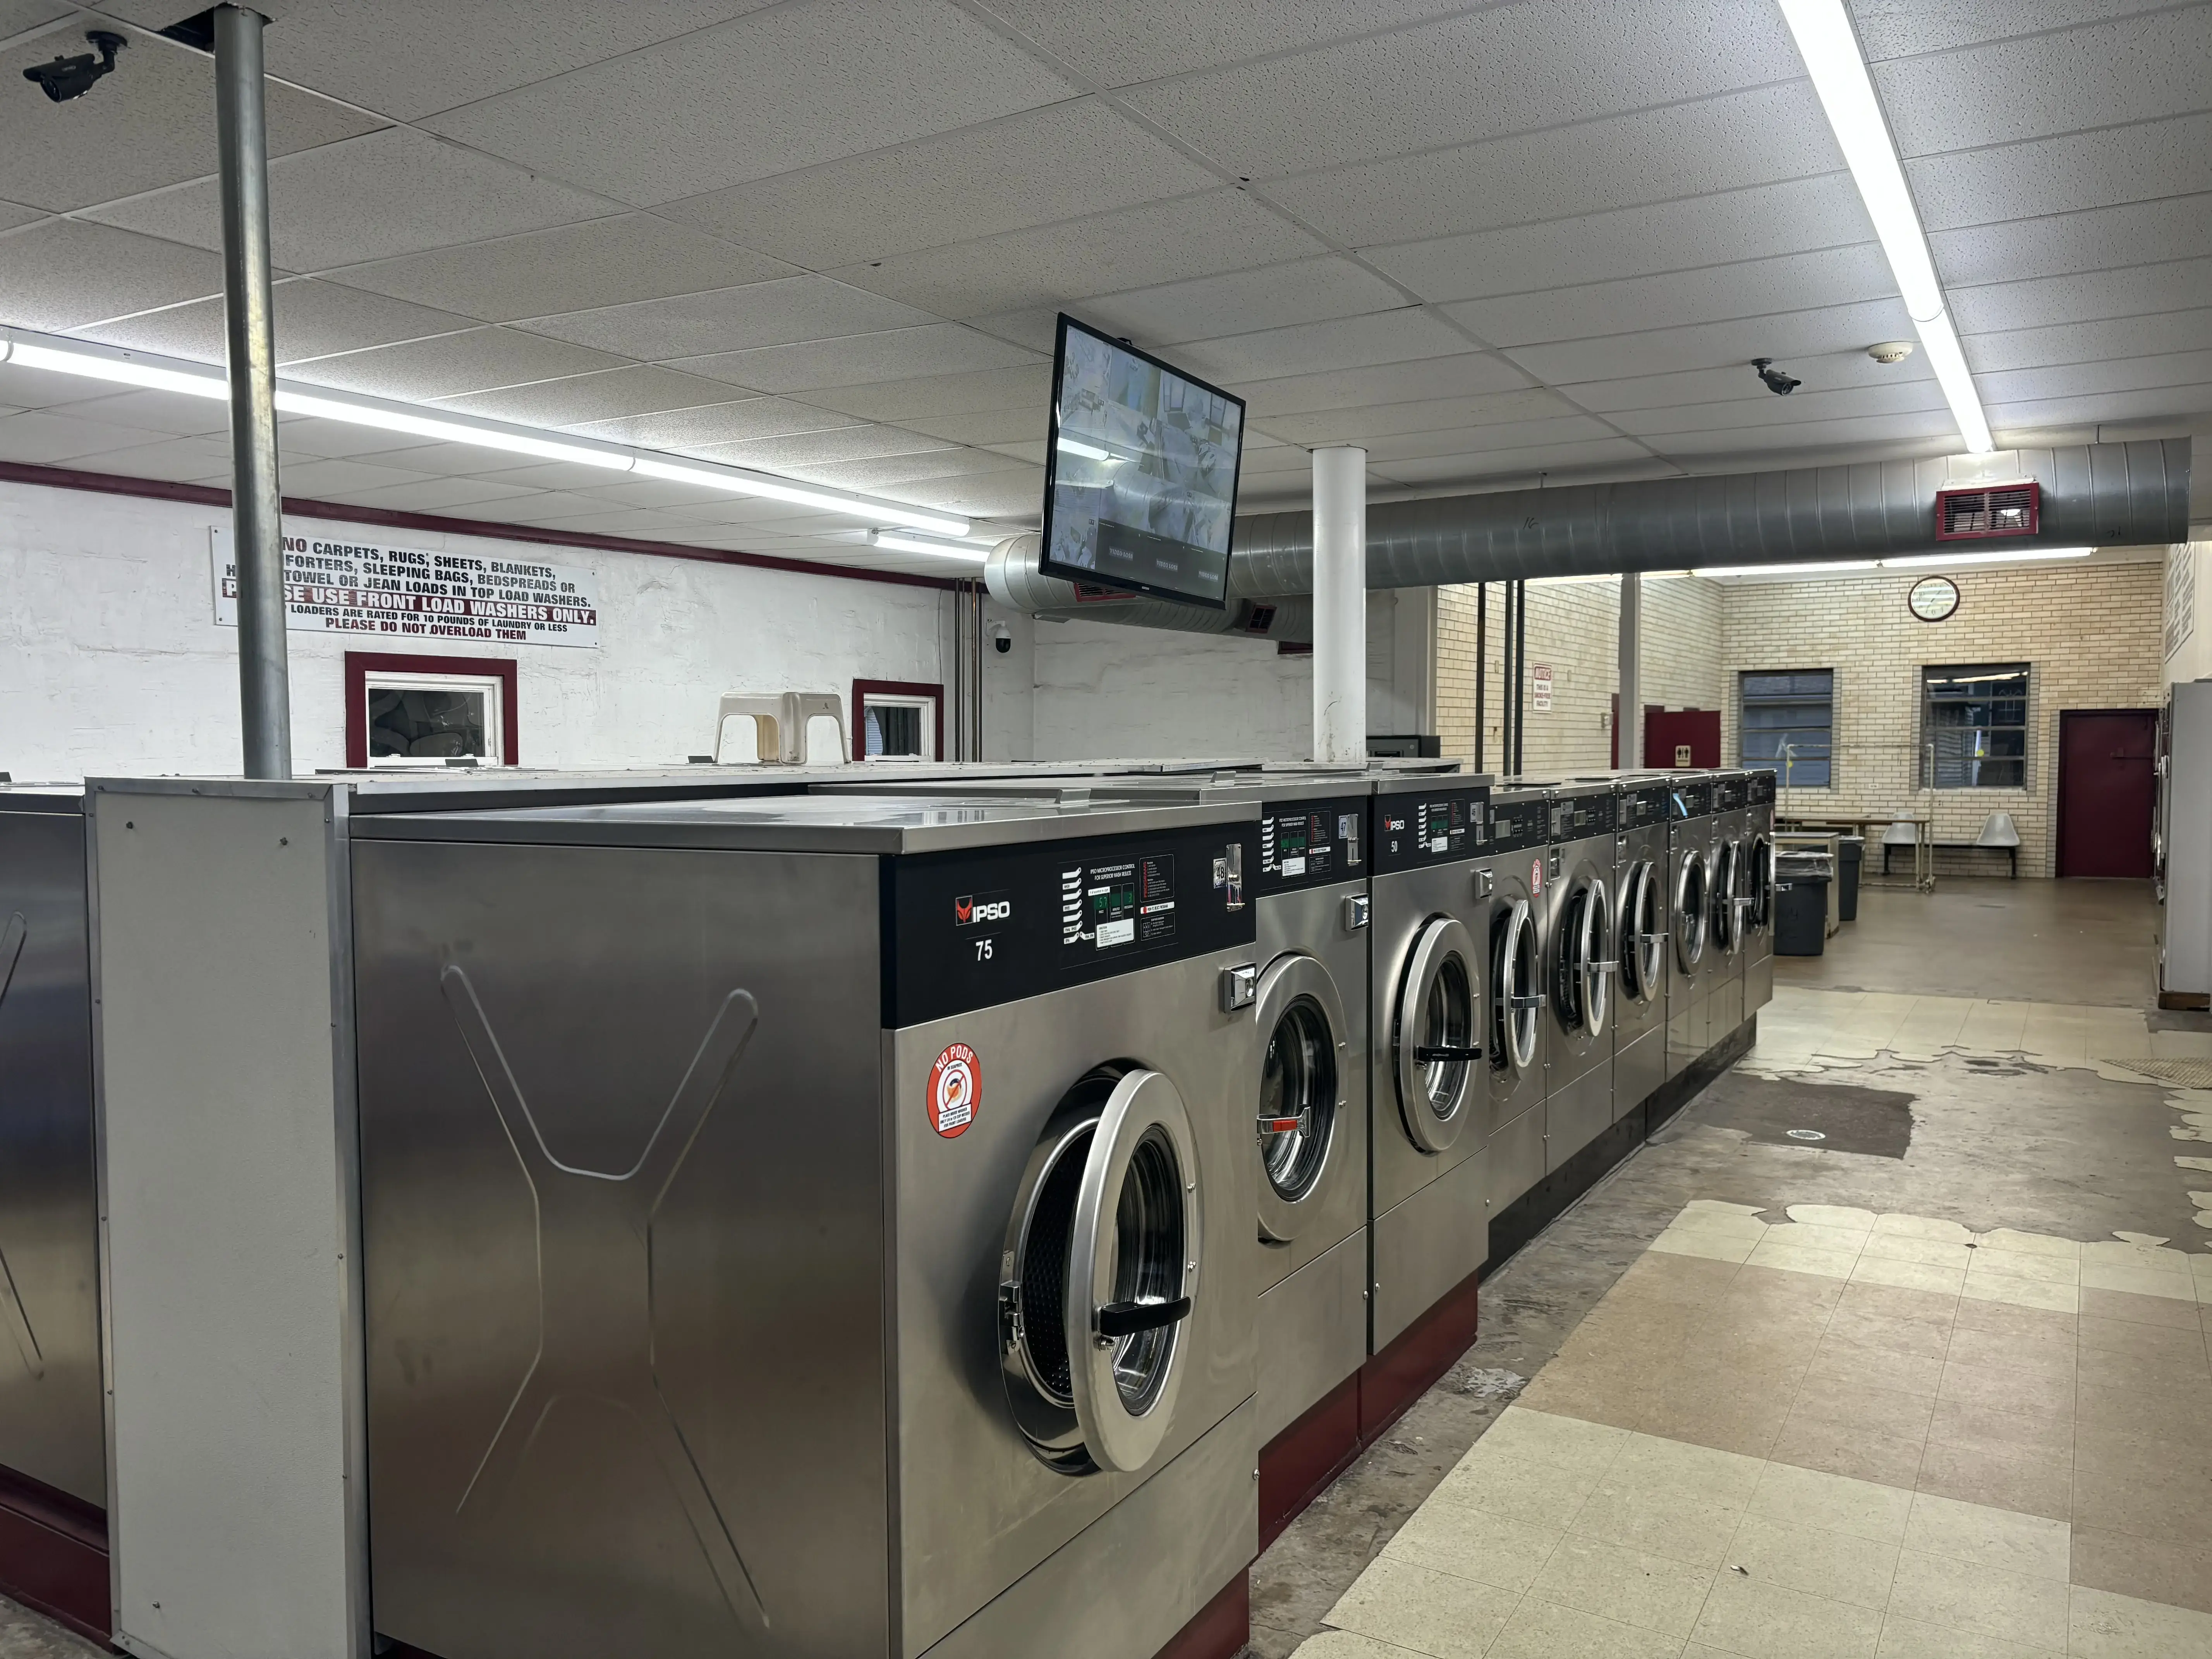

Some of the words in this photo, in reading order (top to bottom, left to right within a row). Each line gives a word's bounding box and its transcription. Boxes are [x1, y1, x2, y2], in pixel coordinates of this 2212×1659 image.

[282, 537, 307, 553] NO
[313, 542, 383, 563] CARPETS,
[389, 551, 429, 567] RUGS,
[434, 556, 487, 573] SHEETS,
[491, 562, 556, 580] BLANKETS,
[1109, 548, 1123, 556] VIDEO
[1123, 550, 1133, 559] LOSS
[1156, 560, 1168, 568] VIDEO
[285, 555, 358, 575] FORTERS,
[363, 562, 430, 580] SLEEPING
[435, 569, 473, 586] BAGS,
[478, 574, 556, 591] BEDSPREADS
[560, 582, 575, 593] OR
[283, 570, 334, 585] TOWEL
[339, 575, 358, 587] OR
[363, 577, 400, 591] JEAN
[406, 580, 448, 595] LOADS
[452, 585, 465, 597] IN
[470, 587, 494, 599] TOP
[499, 589, 529, 601] LOAD
[532, 592, 591, 607] WASHERS.
[312, 587, 349, 605] USE
[356, 591, 416, 610] FRONT
[422, 597, 465, 614] LOAD
[470, 601, 548, 620] WASHERS
[553, 608, 594, 624] ONLY.
[291, 604, 339, 616] LOADERS
[343, 608, 363, 618] ARE
[367, 610, 397, 620] RATED
[401, 612, 419, 622] FOR
[424, 615, 434, 623] 10
[438, 616, 475, 626] POUNDS
[478, 618, 489, 627] OF
[492, 619, 531, 630] LAUNDRY
[534, 622, 545, 630] OR
[548, 623, 568, 632] LESS
[326, 617, 376, 631] PLEASE
[381, 621, 397, 632] DO
[402, 623, 426, 634] NOT
[431, 624, 491, 638] OVERLOAD
[495, 629, 526, 640] THEM
[1390, 820, 1405, 831] IPSO
[1391, 840, 1398, 852] 50
[1216, 866, 1224, 879] 48
[973, 901, 1010, 923] IPSO
[975, 939, 993, 961] 75
[935, 1051, 949, 1072] NO
[950, 1045, 973, 1064] PODS
